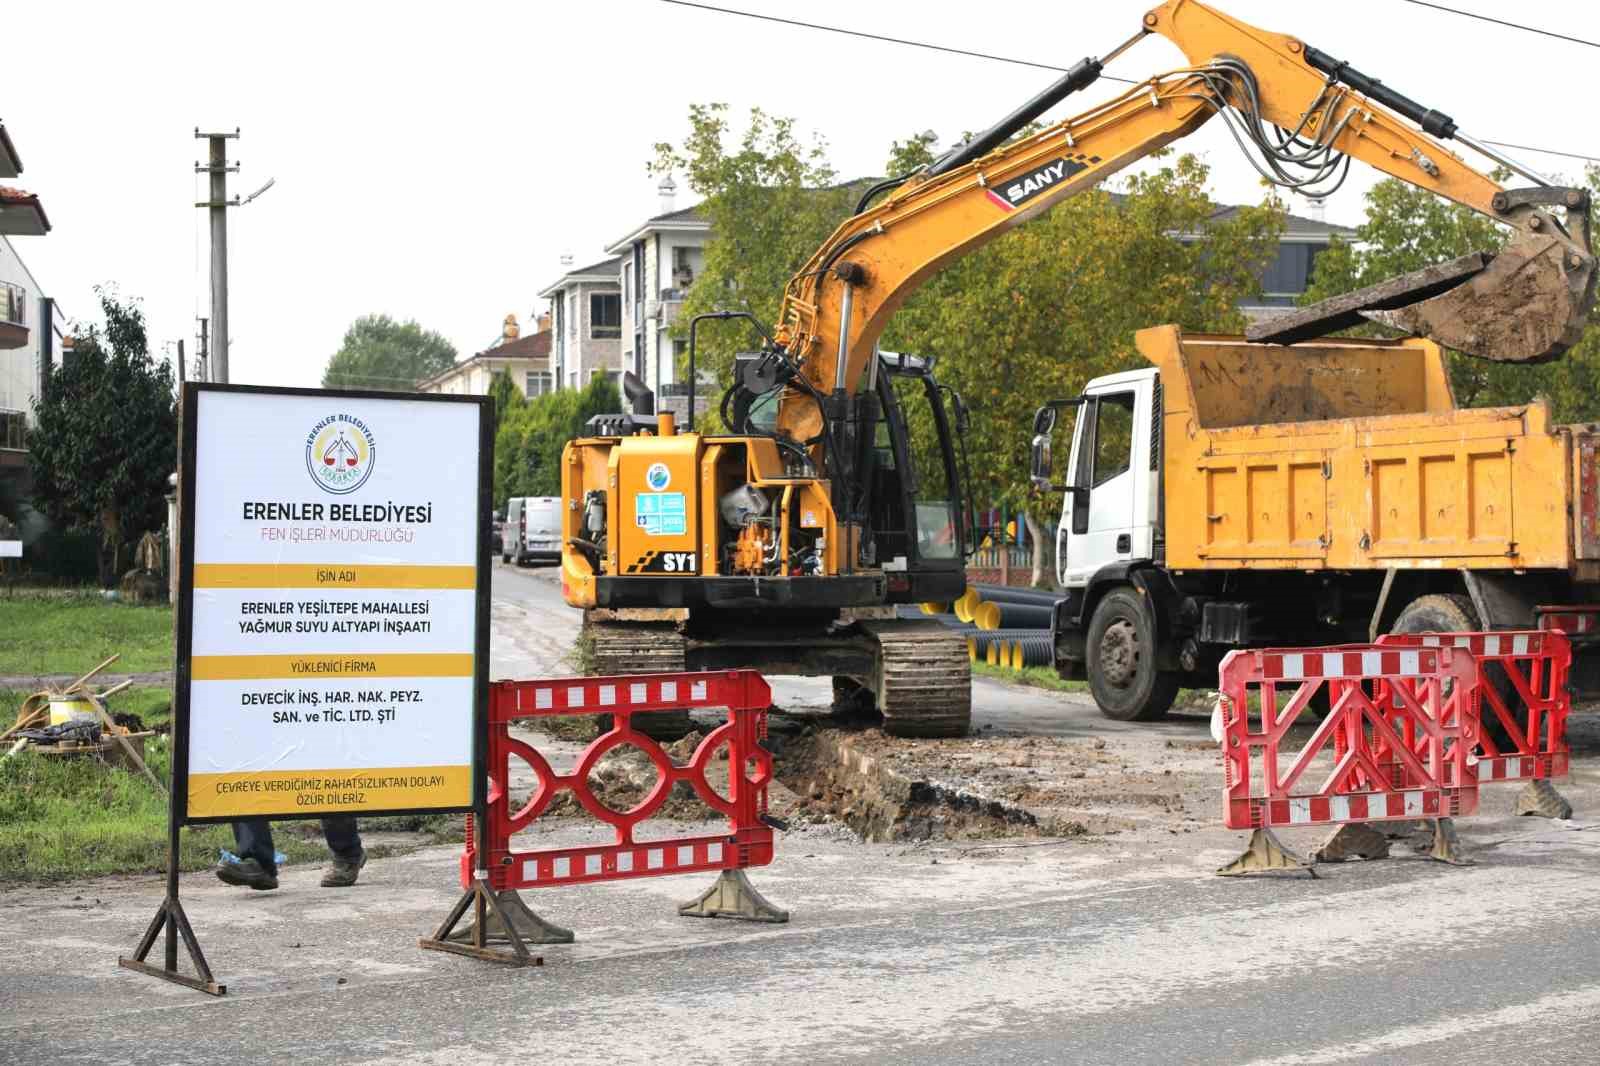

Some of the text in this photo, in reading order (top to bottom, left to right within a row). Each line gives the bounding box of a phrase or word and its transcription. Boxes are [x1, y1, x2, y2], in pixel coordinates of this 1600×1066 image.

[1007, 161, 1064, 202] SANY
[306, 415, 336, 446] ERENLER
[243, 500, 432, 523] ERENLER BELEDİYESİ
[262, 525, 414, 543] FEN İŞLERİ MÜDÜRLÜĞÜ
[663, 553, 696, 572] SY1
[317, 568, 356, 583] İŞİN ADI
[241, 600, 429, 617] ERENLER YEŞİLTEPE MAHALLESİ
[239, 618, 431, 636] YAĞMUR SUYU ALTYAPI İNŞAATI
[291, 659, 376, 673] YÜKLENİCİ FİRMA
[241, 689, 423, 707] DEVECİK İNŞ. HAR. NAK. PEYZ.
[273, 706, 395, 724] SAN. ve TİC. LTD. ŞTİ
[216, 775, 444, 794] ÇEVREYE VERDİĞİMİZ RAHATSIZLIKTAN DOLAYI
[296, 791, 368, 806] ÖZÜR DİLERİZ.
